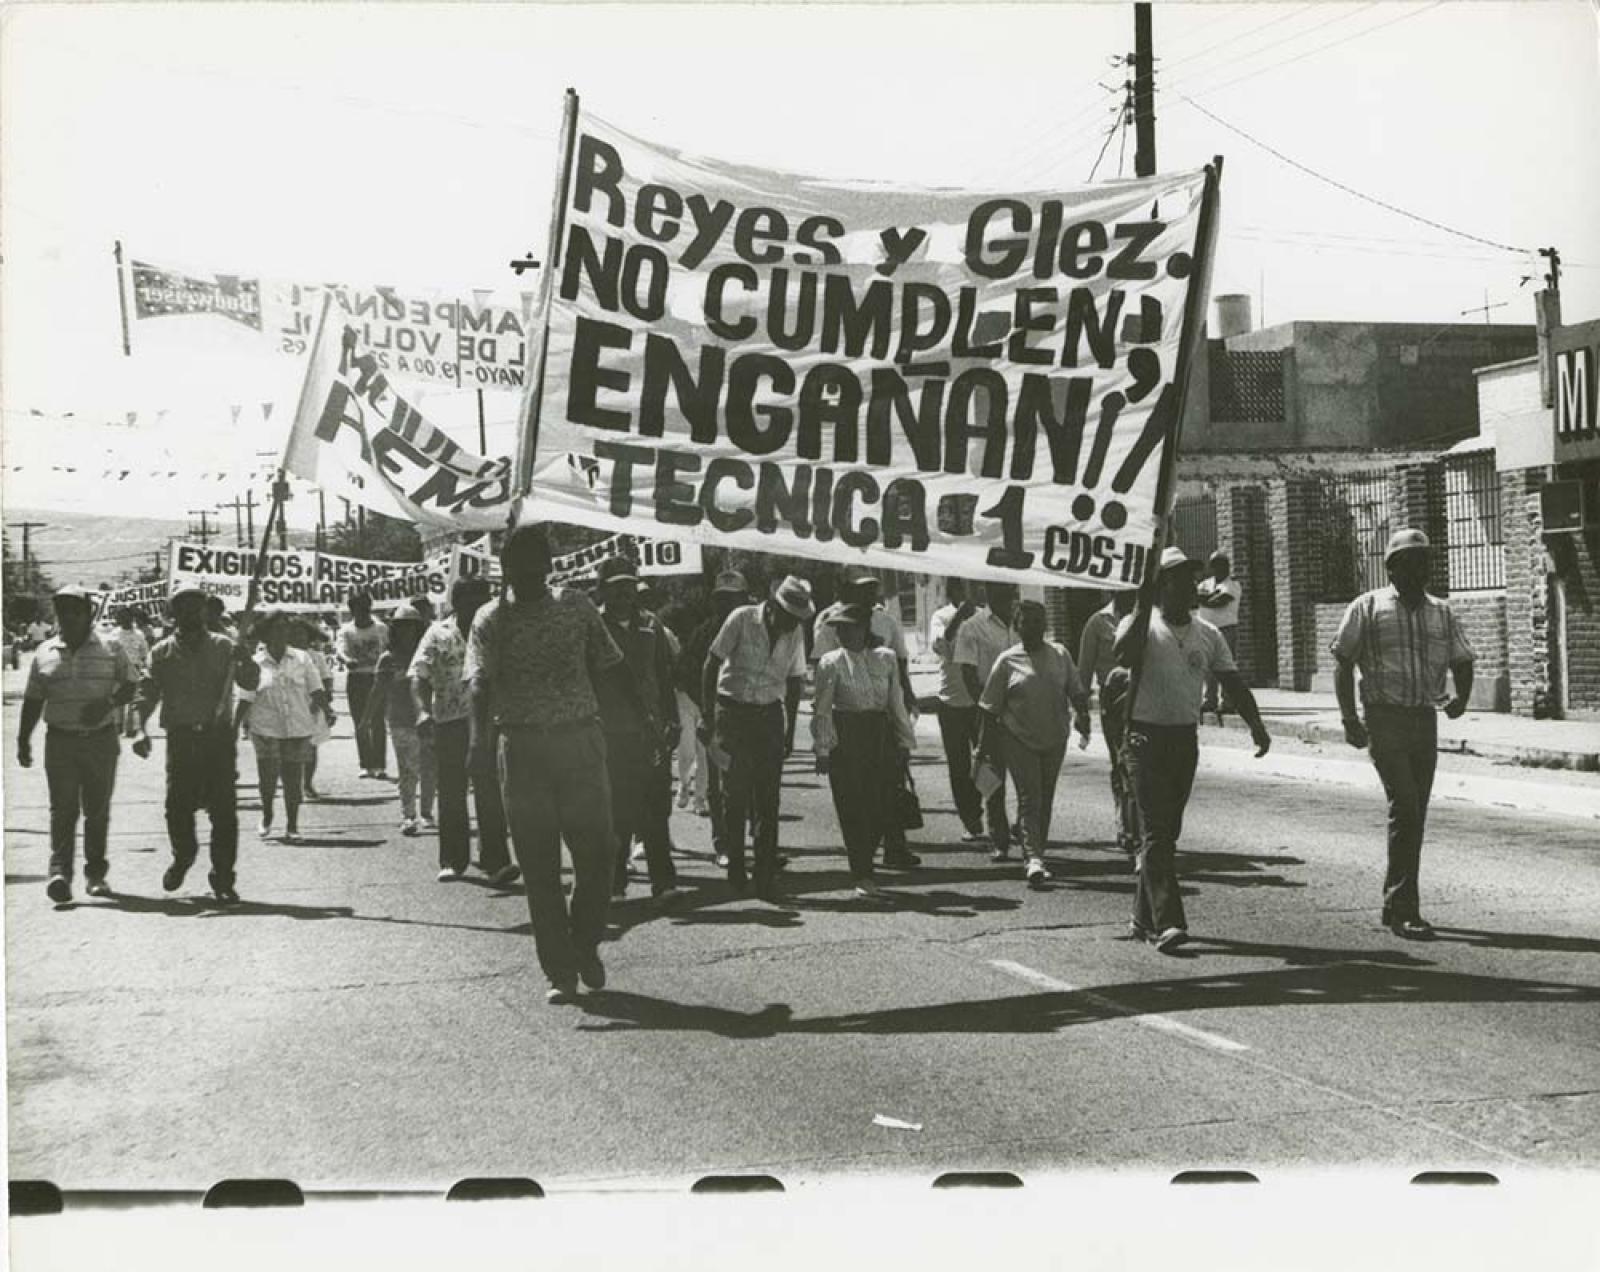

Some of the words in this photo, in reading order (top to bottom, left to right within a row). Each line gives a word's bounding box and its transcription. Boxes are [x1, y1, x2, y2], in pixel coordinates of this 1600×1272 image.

[573, 133, 847, 270] Reyes
[874, 225, 928, 276] y
[964, 198, 1192, 280] Glez.
[560, 224, 670, 322] NO
